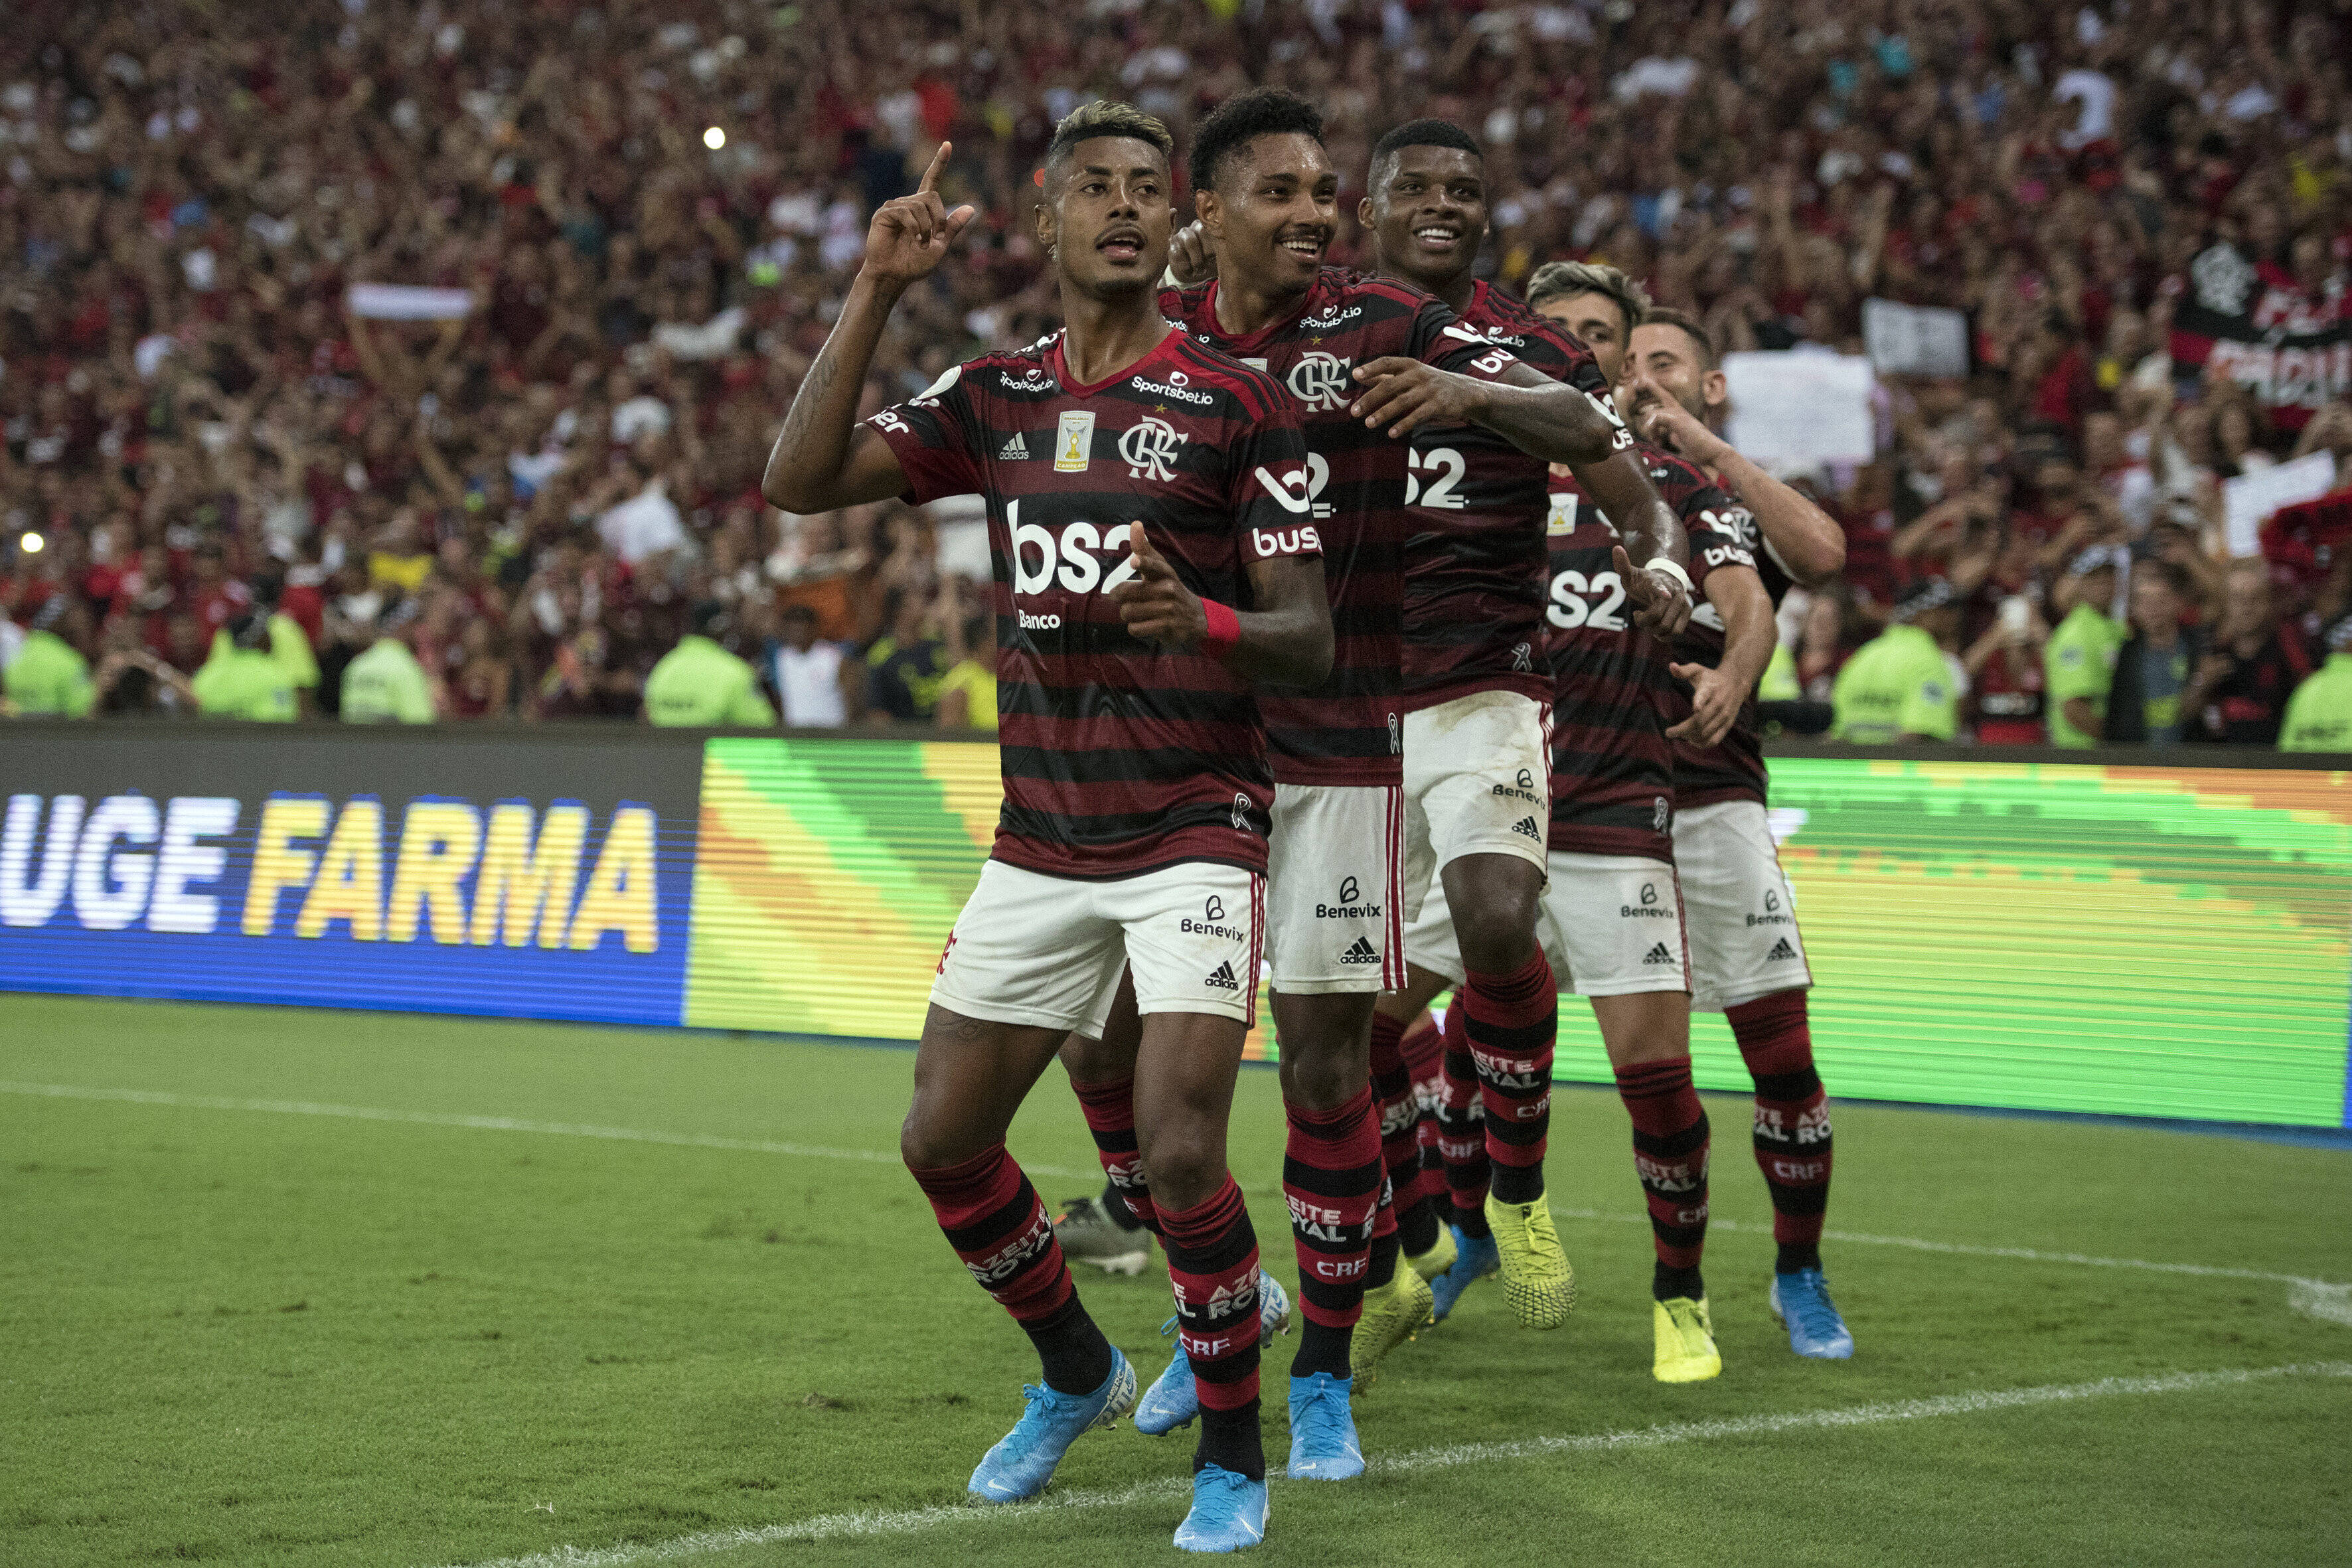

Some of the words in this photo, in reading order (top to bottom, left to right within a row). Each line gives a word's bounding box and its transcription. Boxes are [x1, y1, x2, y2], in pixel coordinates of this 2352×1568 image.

[1470, 348, 1514, 374] bu
[1131, 376, 1214, 405] Sportsbet.io
[874, 412, 909, 433] er
[1612, 428, 1634, 449] us
[999, 449, 1029, 460] adidas
[1006, 499, 1144, 595] bs2
[1252, 526, 1323, 557] bus
[1703, 544, 1757, 569] bus
[1018, 609, 1061, 629] Banco
[0, 794, 242, 933] UGE
[239, 796, 660, 953] FARMA
[1316, 902, 1381, 919] Benevix
[1181, 918, 1244, 943] Benevix
[1340, 954, 1381, 965] adidas
[1204, 976, 1239, 991] adidas
[1283, 1193, 1341, 1225] EITE
[1316, 1257, 1368, 1277] CRF
[1180, 1332, 1231, 1356] CRF
